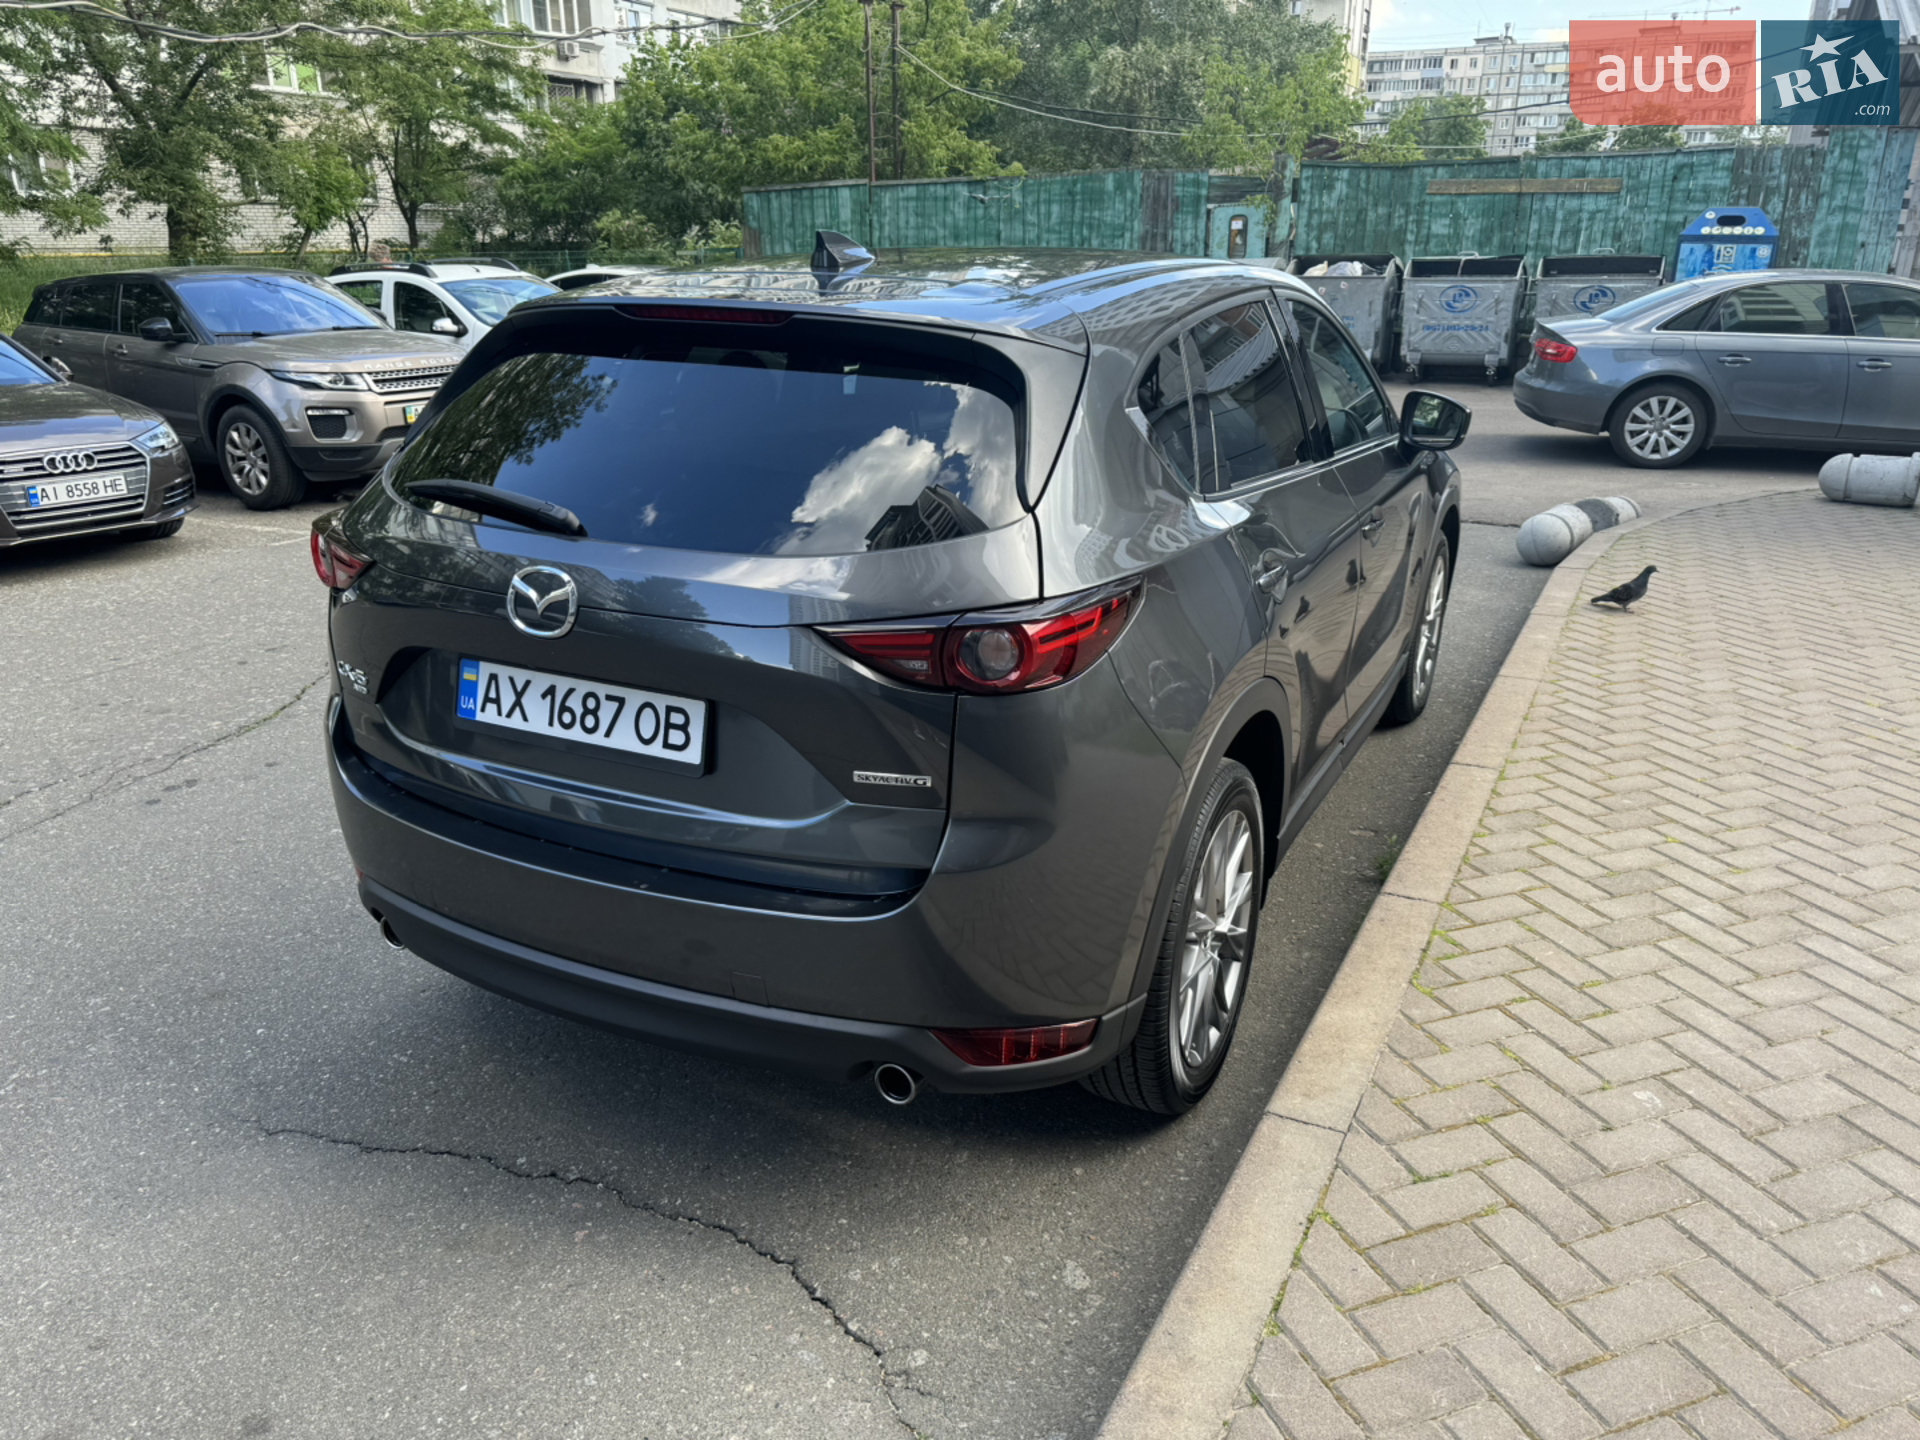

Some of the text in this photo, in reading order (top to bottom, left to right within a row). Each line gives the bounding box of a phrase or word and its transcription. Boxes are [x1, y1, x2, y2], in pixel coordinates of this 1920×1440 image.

[363, 360, 413, 369] RANGE
[65, 481, 100, 498] 8558
[103, 478, 125, 494] HE
[461, 695, 475, 709] UA
[480, 672, 691, 752] AX 1687 OB
